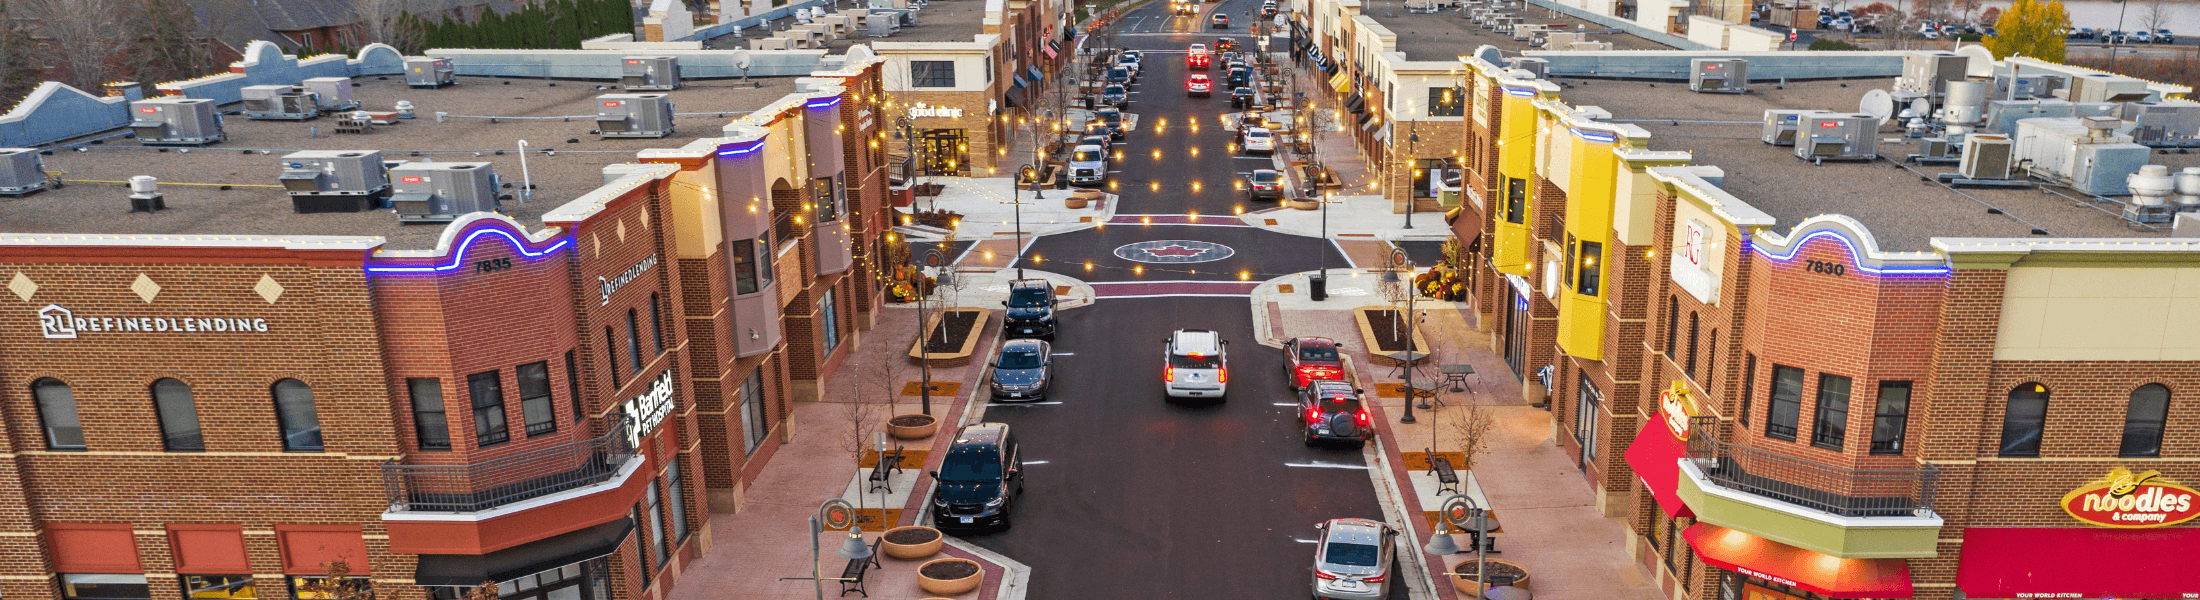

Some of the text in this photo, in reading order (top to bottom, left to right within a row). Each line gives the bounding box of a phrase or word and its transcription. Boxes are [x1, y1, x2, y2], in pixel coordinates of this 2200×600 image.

[908, 105, 963, 119] good clinic
[473, 257, 512, 273] 7835
[1806, 259, 1845, 276] 7830
[638, 369, 673, 421] Banfield
[642, 396, 675, 437] PET HOSPITAL
[2082, 487, 2192, 512] noodles
[2112, 512, 2167, 523] & company
[1737, 566, 1797, 587] YOUR WORLD KITCHEN
